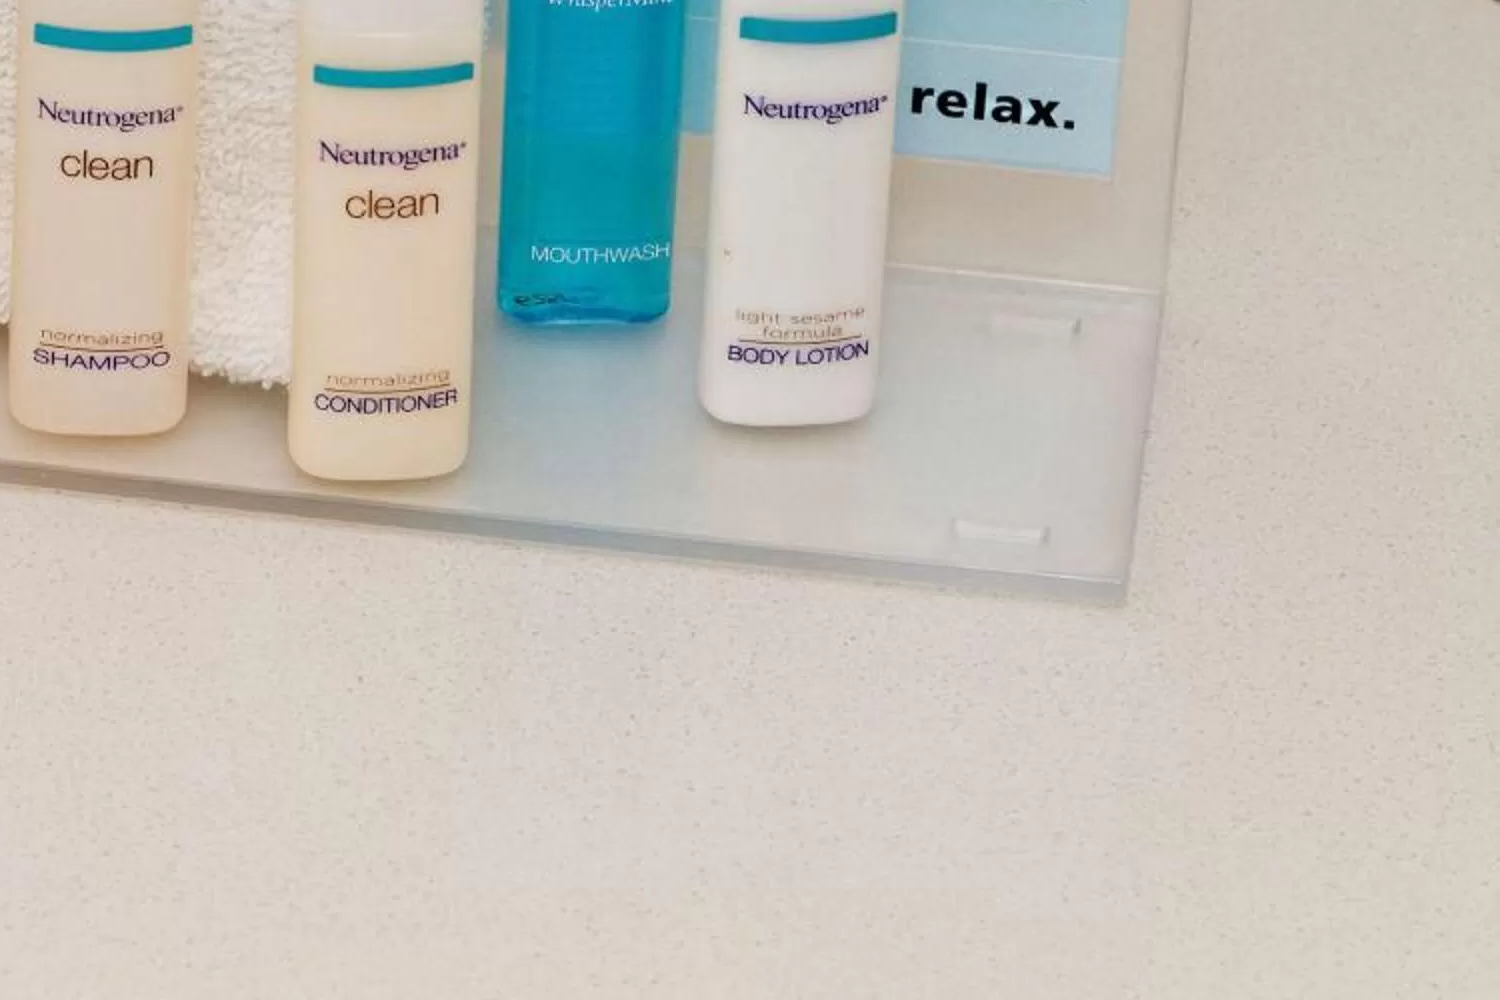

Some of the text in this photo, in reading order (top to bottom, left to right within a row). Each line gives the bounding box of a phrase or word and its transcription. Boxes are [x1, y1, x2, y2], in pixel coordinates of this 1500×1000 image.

[910, 82, 1076, 130] relax.
[61, 150, 153, 180] clean
[345, 190, 439, 219] clean
[531, 242, 670, 265] MOUTHWASH
[735, 306, 865, 325] light sesame
[40, 329, 164, 346] normalizing
[763, 326, 842, 340] formula
[33, 348, 171, 371] SHAMPOO
[727, 340, 869, 365] BODY LOTION
[326, 370, 450, 387] normalizing
[314, 389, 458, 414] CONDITIONER
